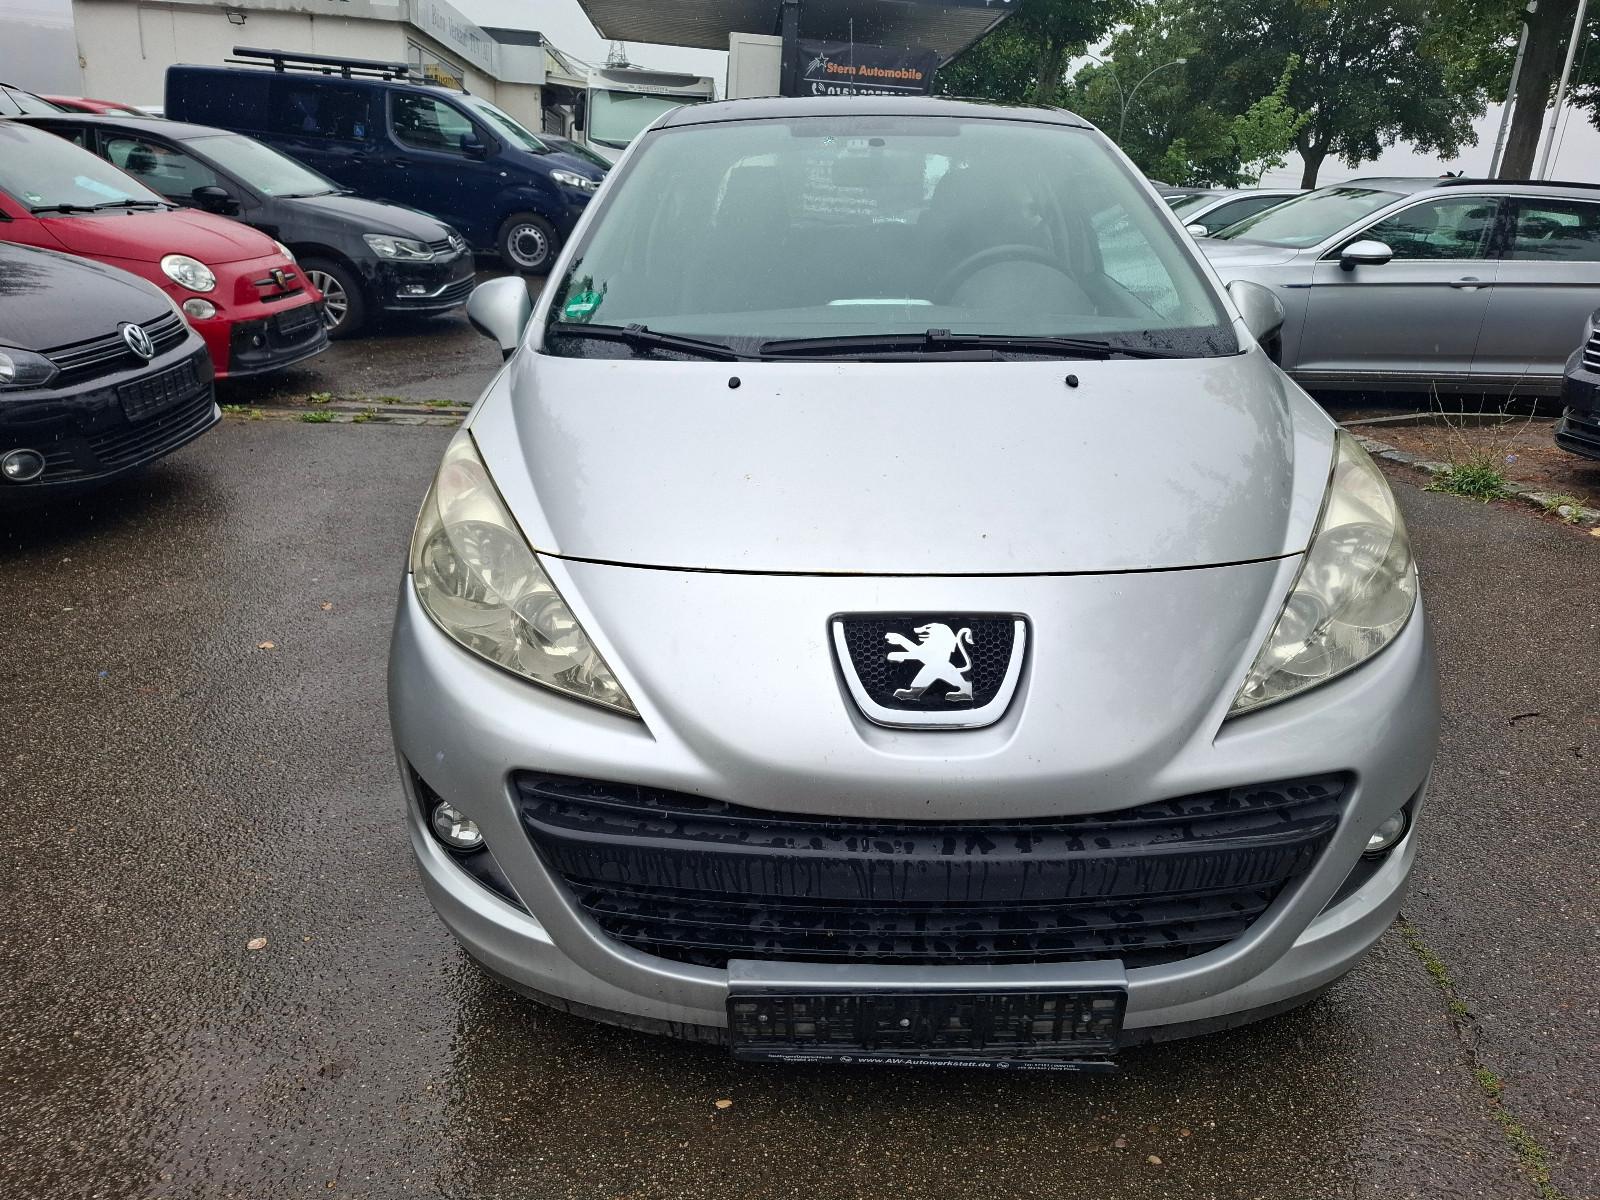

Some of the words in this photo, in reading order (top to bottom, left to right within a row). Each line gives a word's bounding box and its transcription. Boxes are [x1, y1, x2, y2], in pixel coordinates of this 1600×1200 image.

[827, 62, 856, 75] Stern
[859, 65, 922, 80] Automobile
[858, 1057, 992, 1069] www.AW-Autowerkstatt.de
